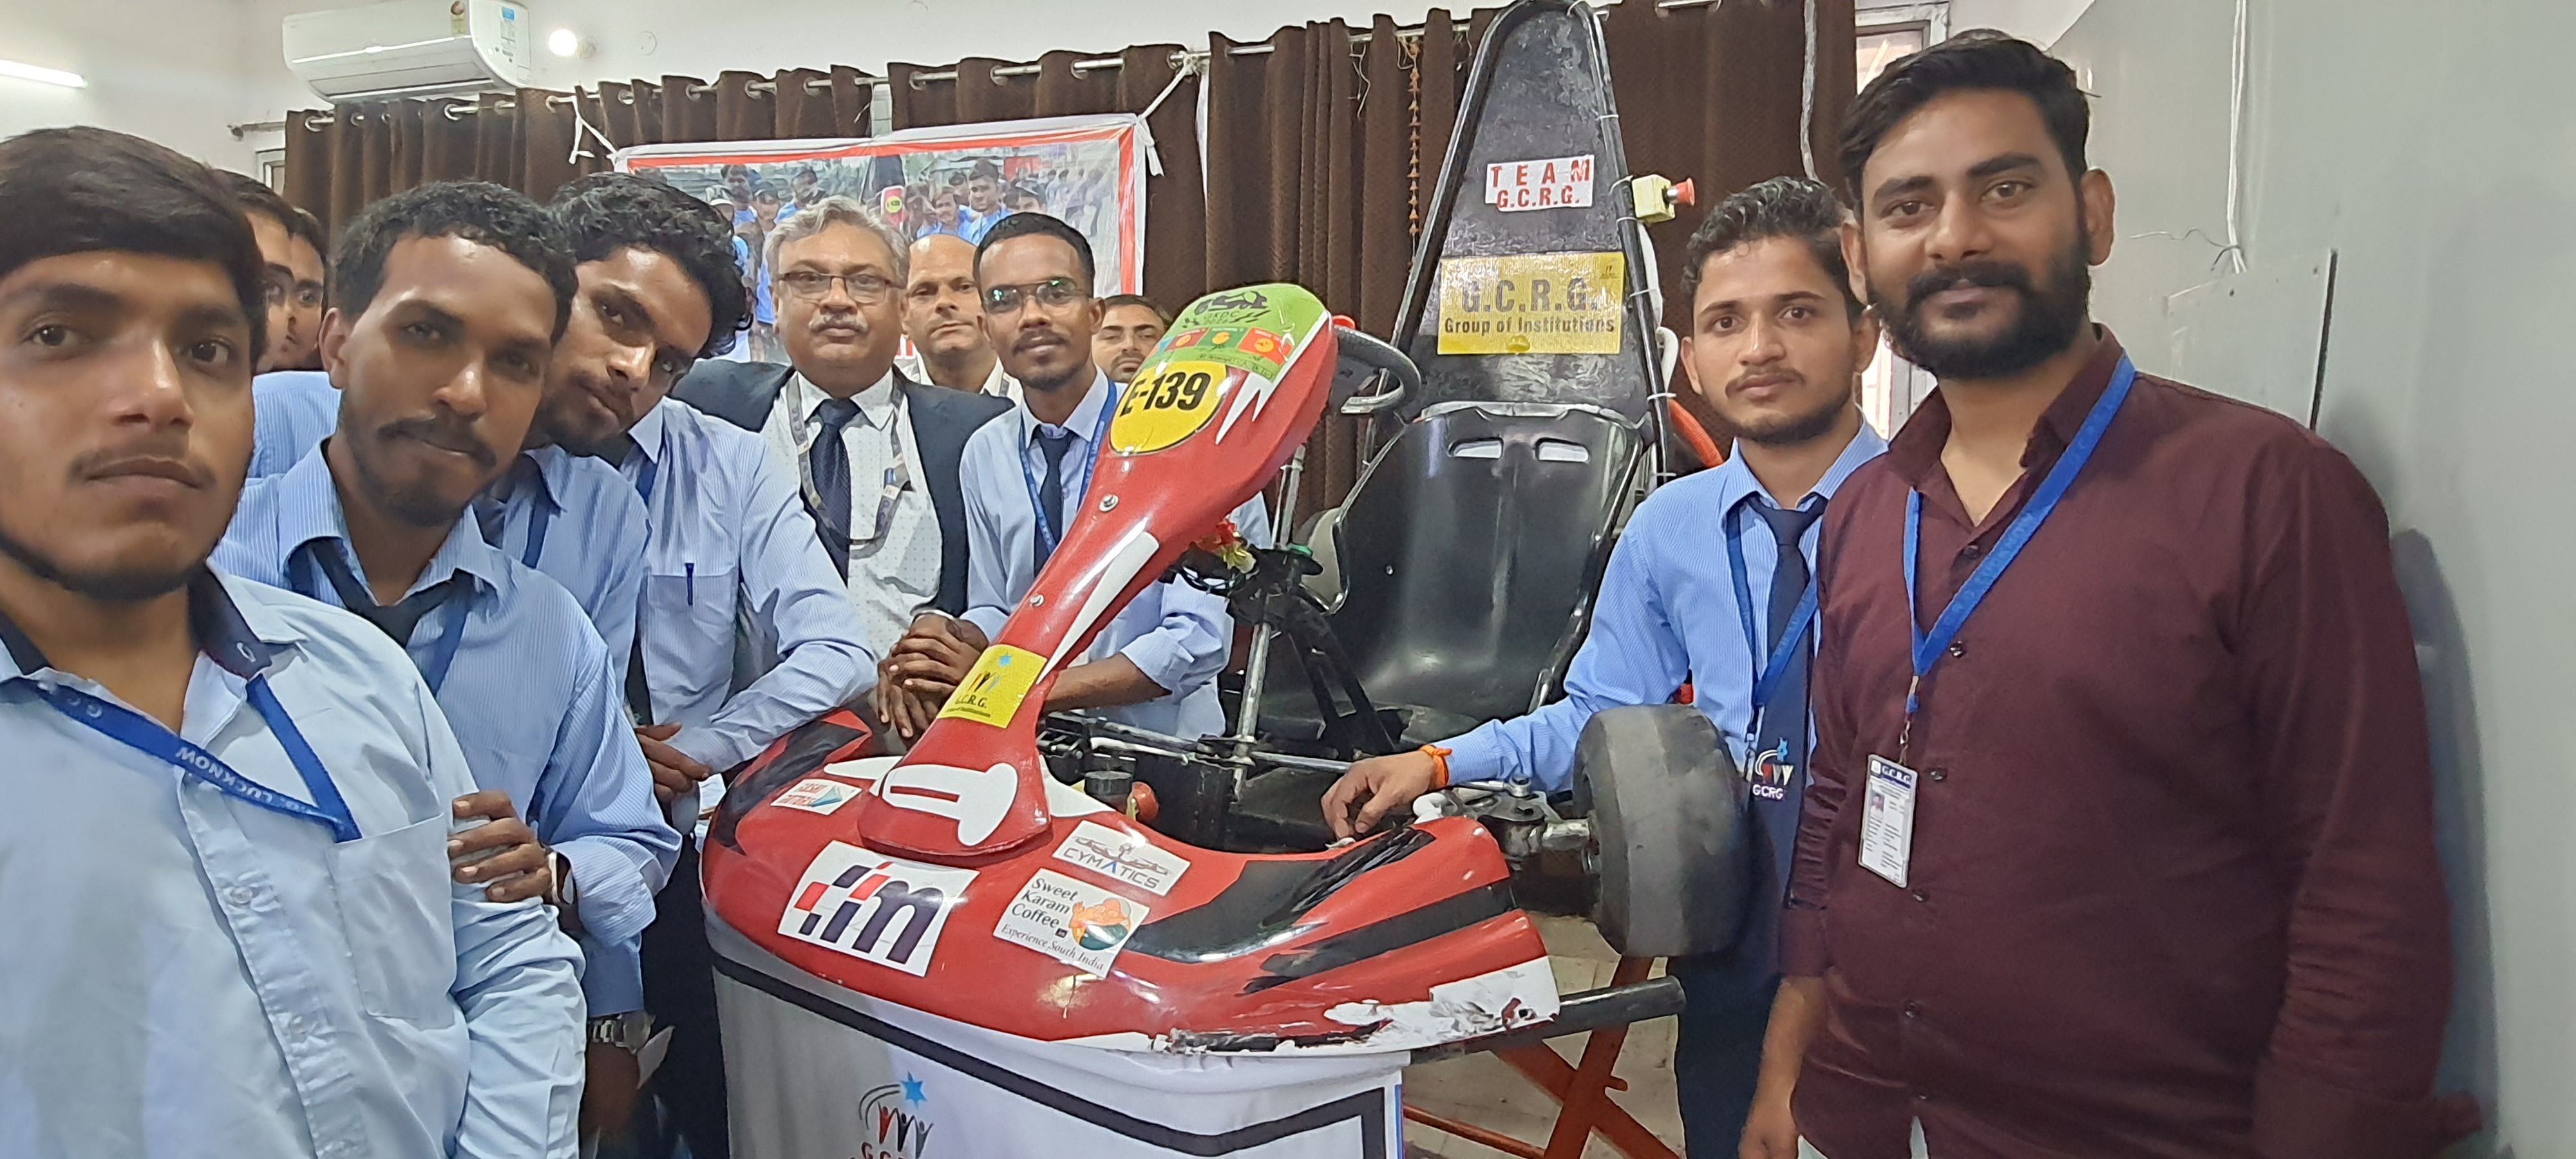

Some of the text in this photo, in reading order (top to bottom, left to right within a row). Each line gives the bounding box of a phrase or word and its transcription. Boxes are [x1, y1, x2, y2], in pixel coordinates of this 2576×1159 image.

[1490, 159, 1591, 187] TEAM
[1497, 185, 1580, 209] G.C.R.G.
[1444, 316, 1615, 336] Group of Institutions
[1119, 372, 1211, 417] E-139
[175, 747, 273, 804] LUCKNOW
[1752, 784, 1785, 800] GCRG
[1063, 847, 1160, 889] CYMATICS
[1021, 890, 1072, 914] Karam
[1031, 878, 1079, 901] Sweet
[1012, 903, 1060, 928] Coffee
[1001, 923, 1104, 971] Experience South India
